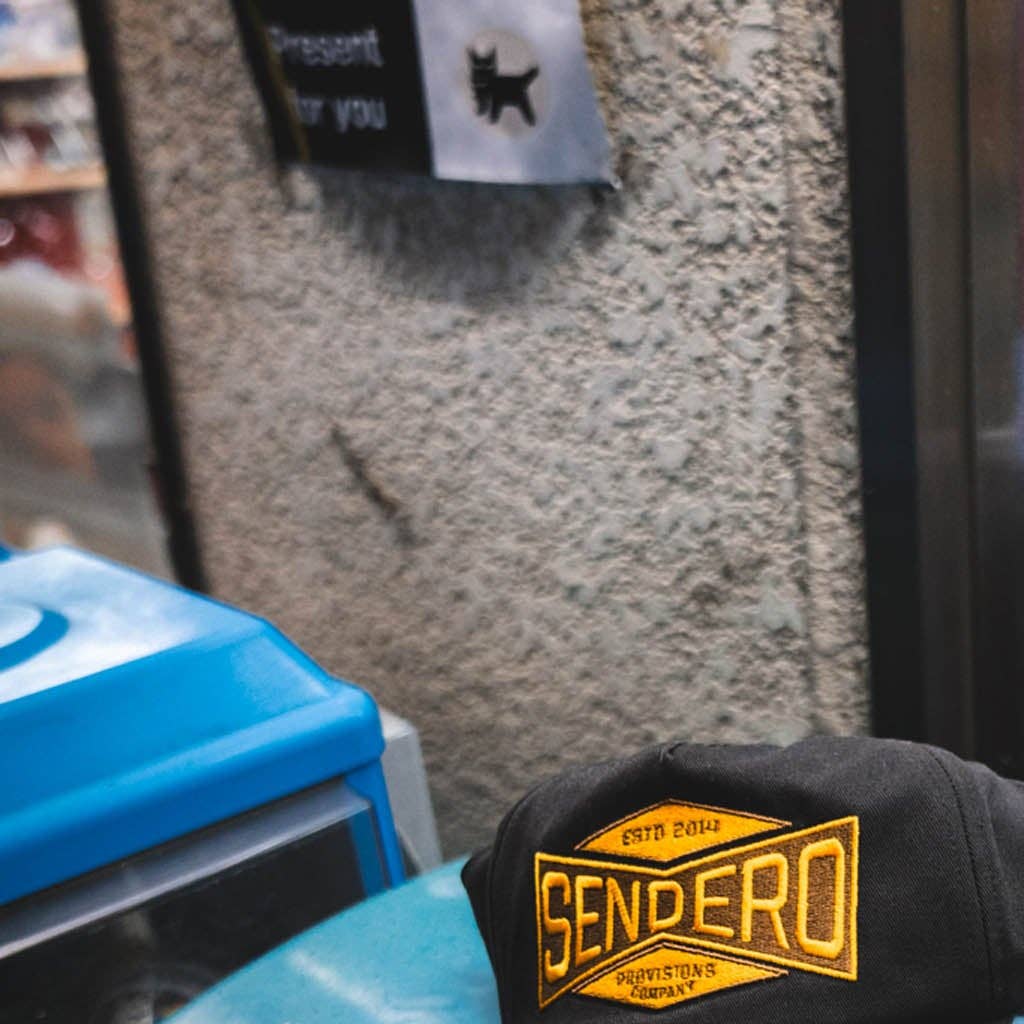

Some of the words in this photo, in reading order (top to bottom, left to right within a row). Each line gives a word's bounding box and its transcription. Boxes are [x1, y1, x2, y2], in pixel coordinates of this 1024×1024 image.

[336, 98, 387, 133] you
[621, 822, 665, 846] ESTD
[673, 819, 721, 839] 2014
[541, 837, 845, 983] SENDERO
[616, 962, 717, 987] PROVISIONS
[630, 980, 696, 1001] COMPANY
